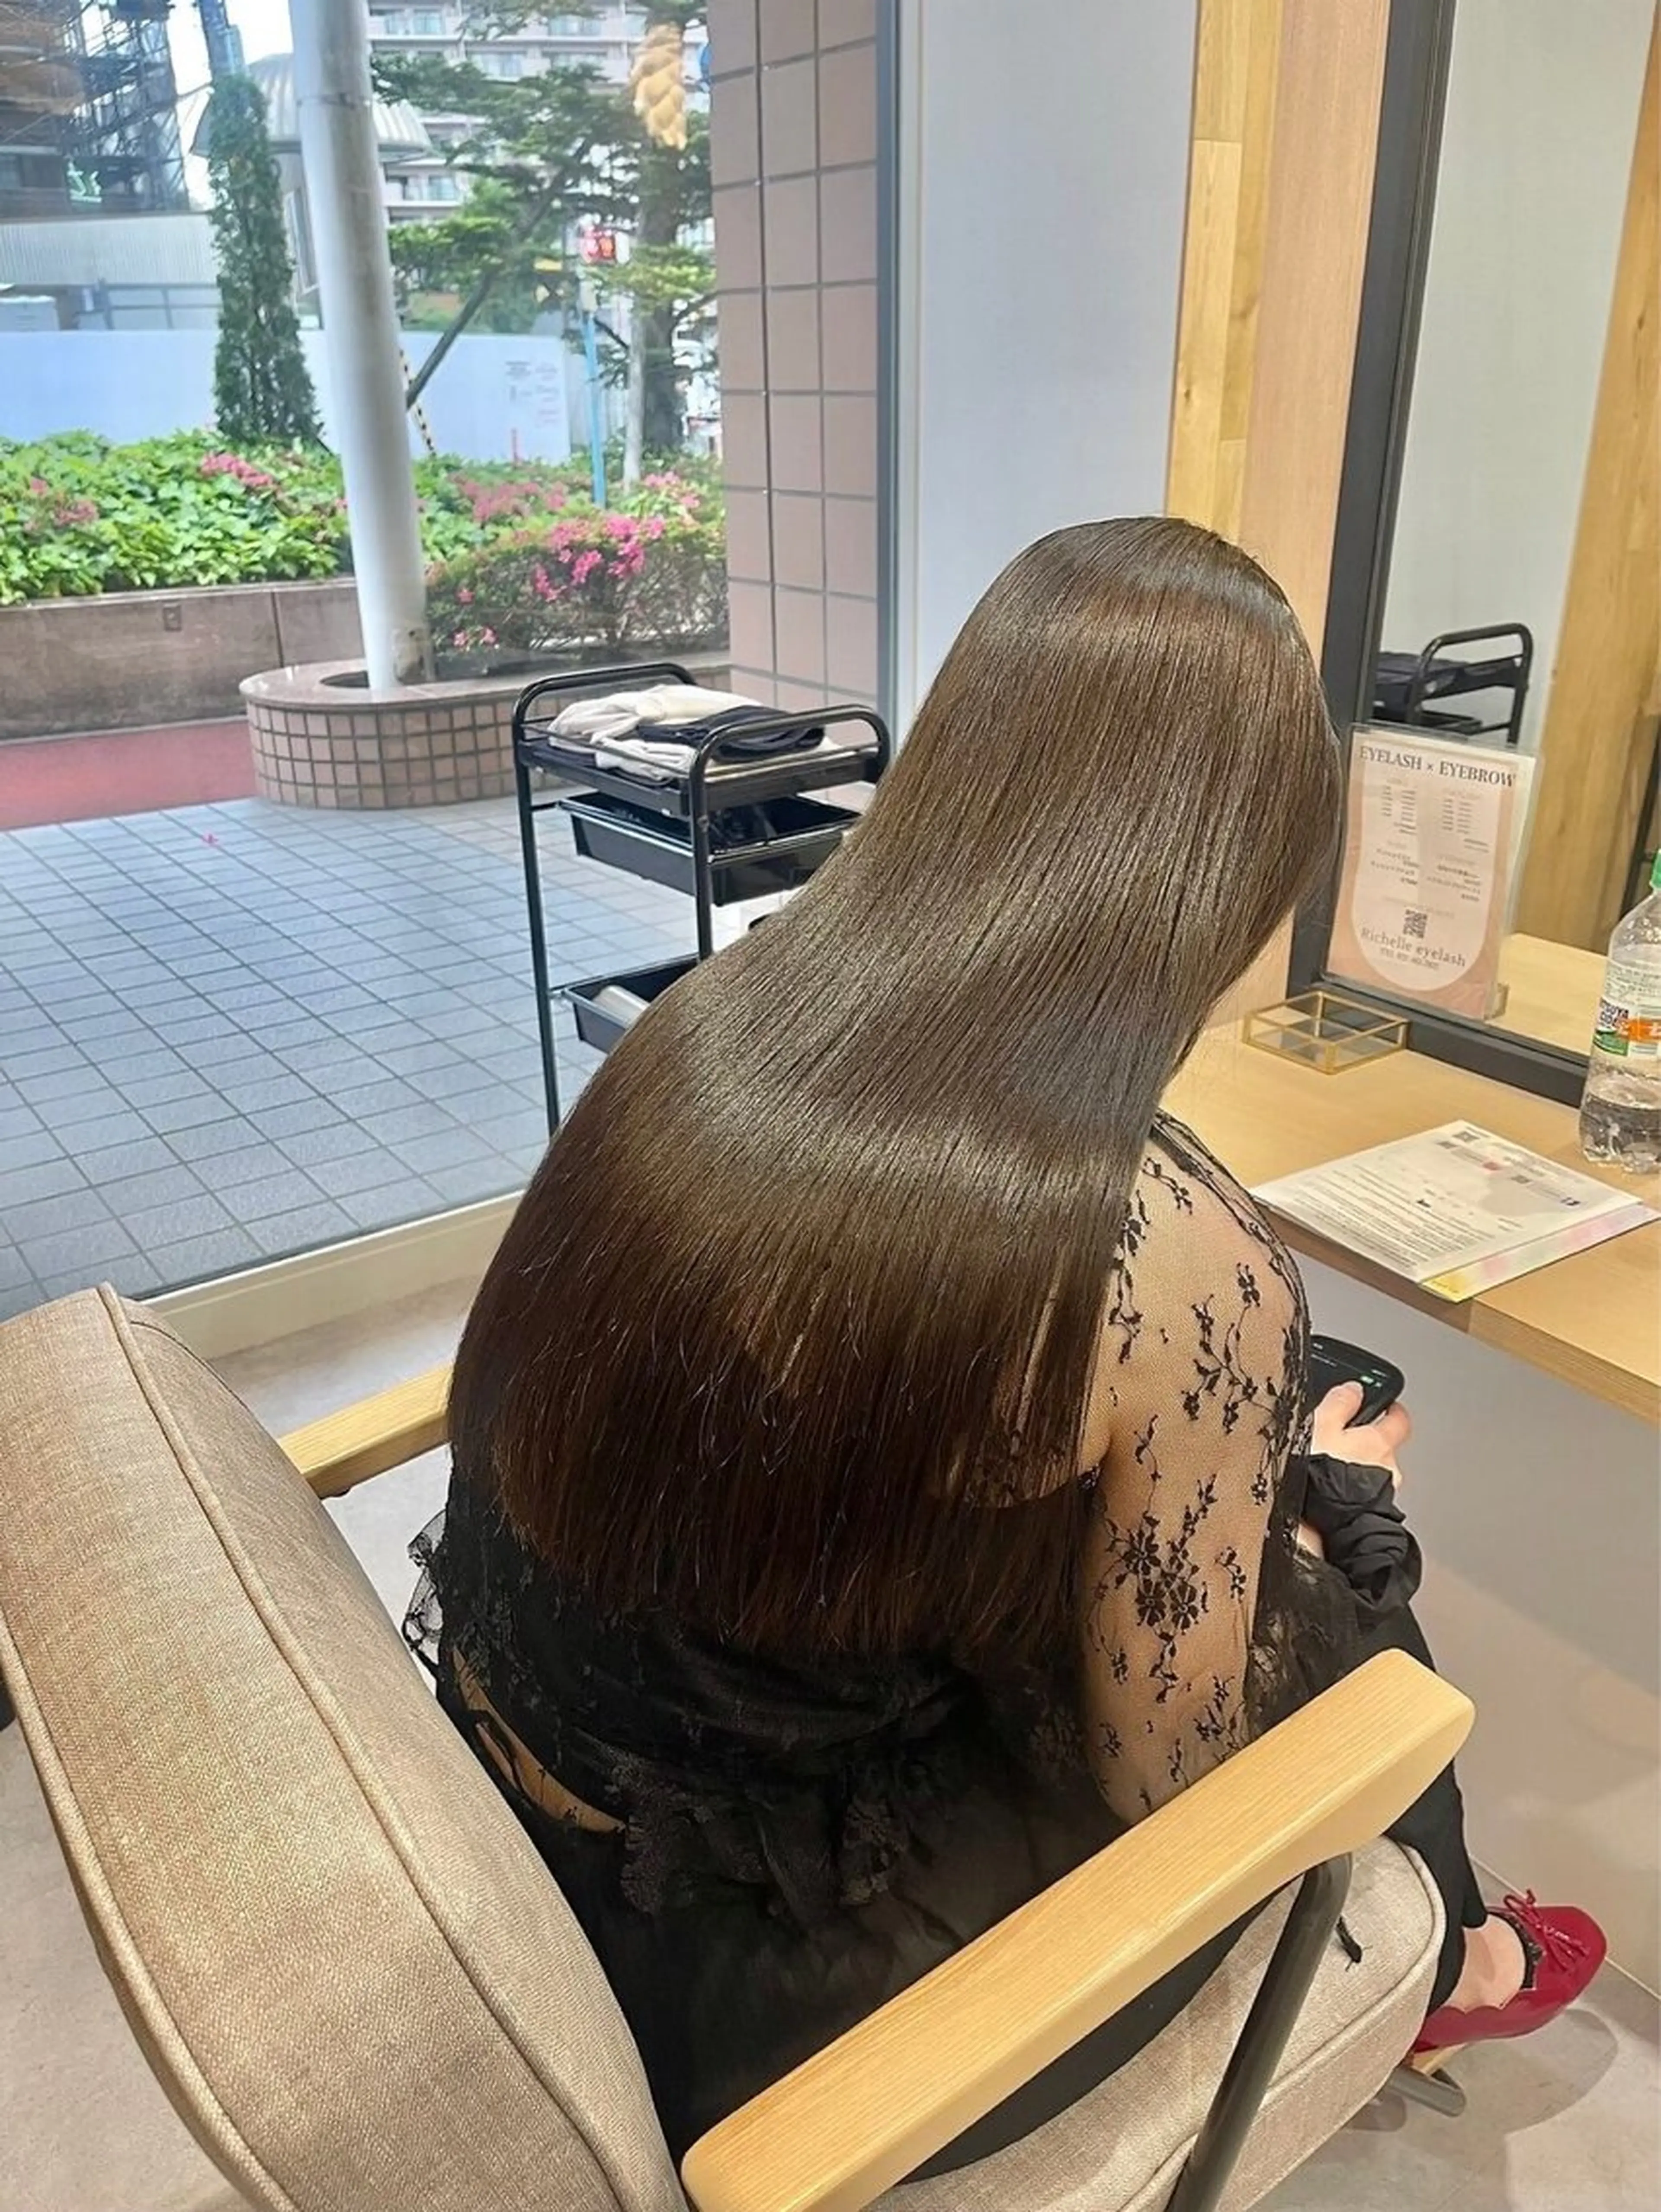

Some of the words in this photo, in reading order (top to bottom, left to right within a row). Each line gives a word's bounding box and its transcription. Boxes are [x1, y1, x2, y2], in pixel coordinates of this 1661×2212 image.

[1360, 746, 1422, 770] EYELASH
[1439, 760, 1516, 787] EYEBROW
[1361, 927, 1412, 952] Richelle
[1416, 946, 1465, 967] eyelash
